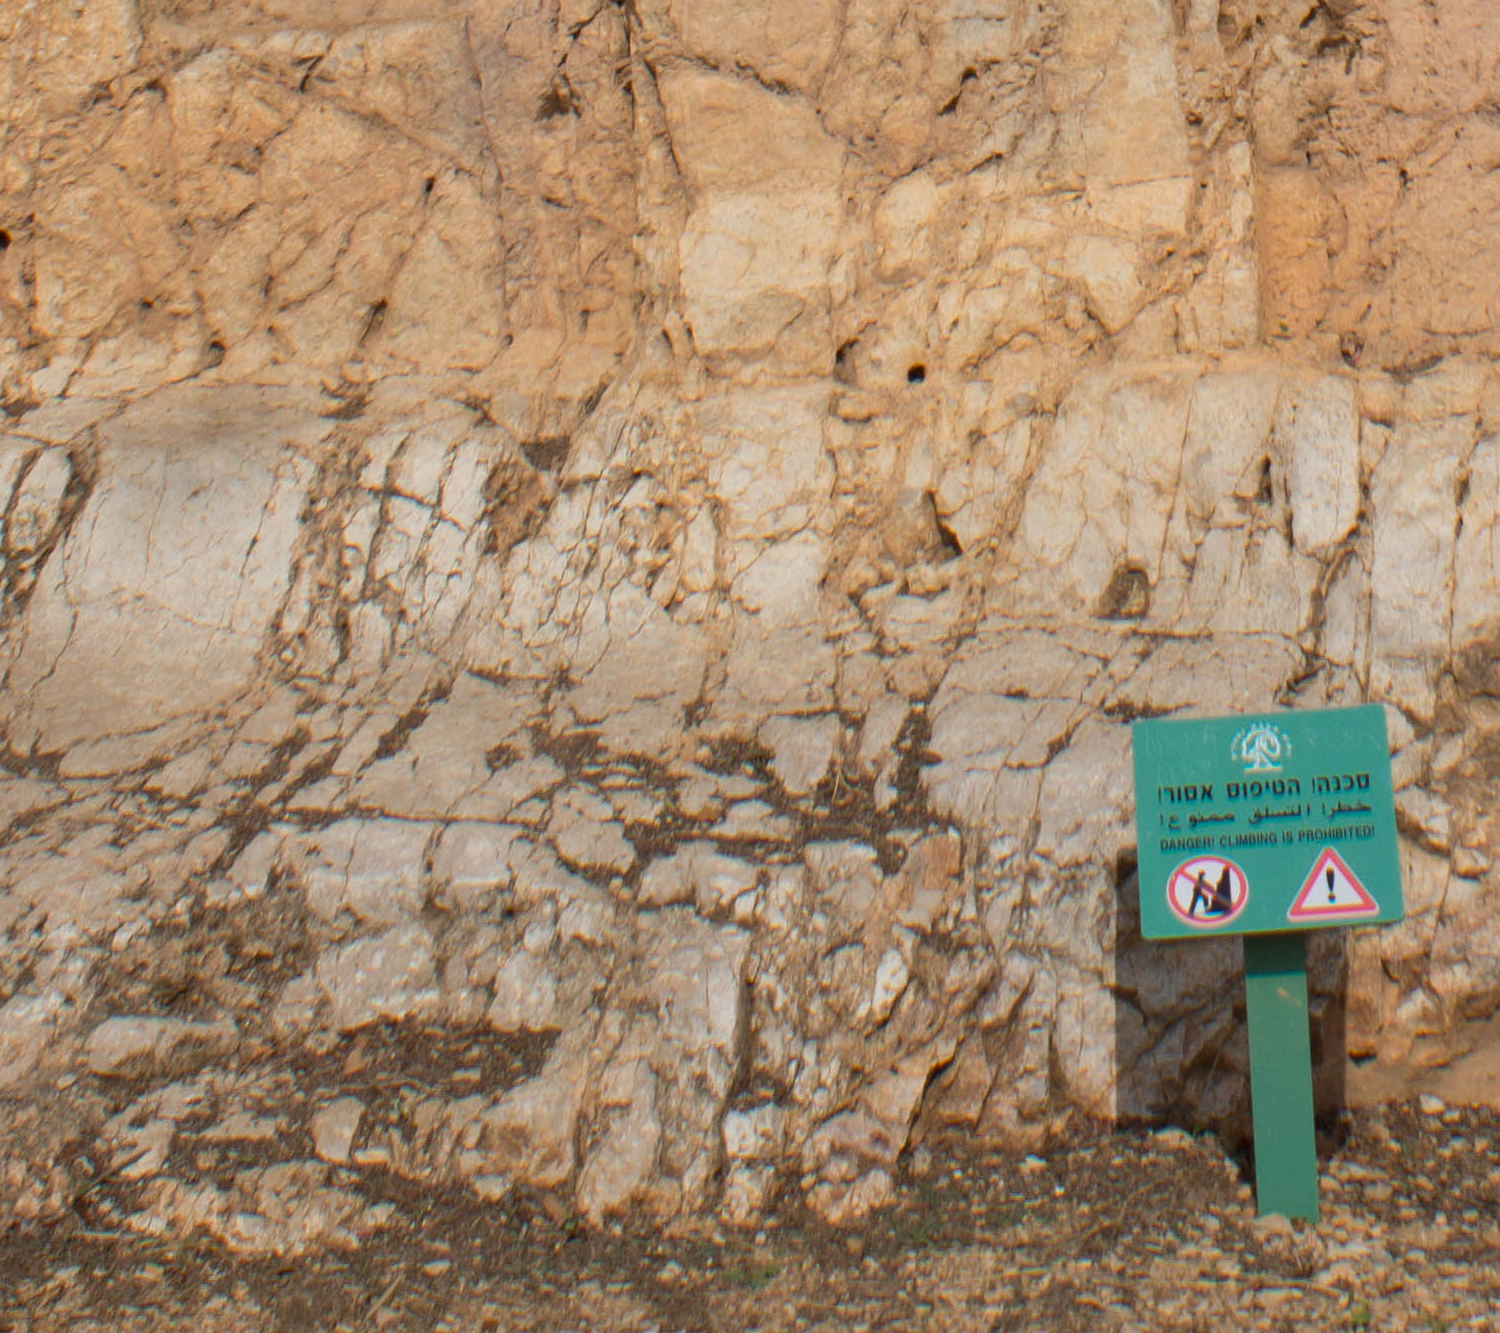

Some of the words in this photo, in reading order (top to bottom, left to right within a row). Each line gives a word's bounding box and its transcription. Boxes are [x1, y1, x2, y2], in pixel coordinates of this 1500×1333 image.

[1226, 778, 1300, 798] הטיפוס
[1160, 837, 1215, 851] DANGER!
[1219, 830, 1278, 849] CLIMBING
[1282, 829, 1294, 844] IS
[1298, 824, 1375, 842] PROHIBITED!
